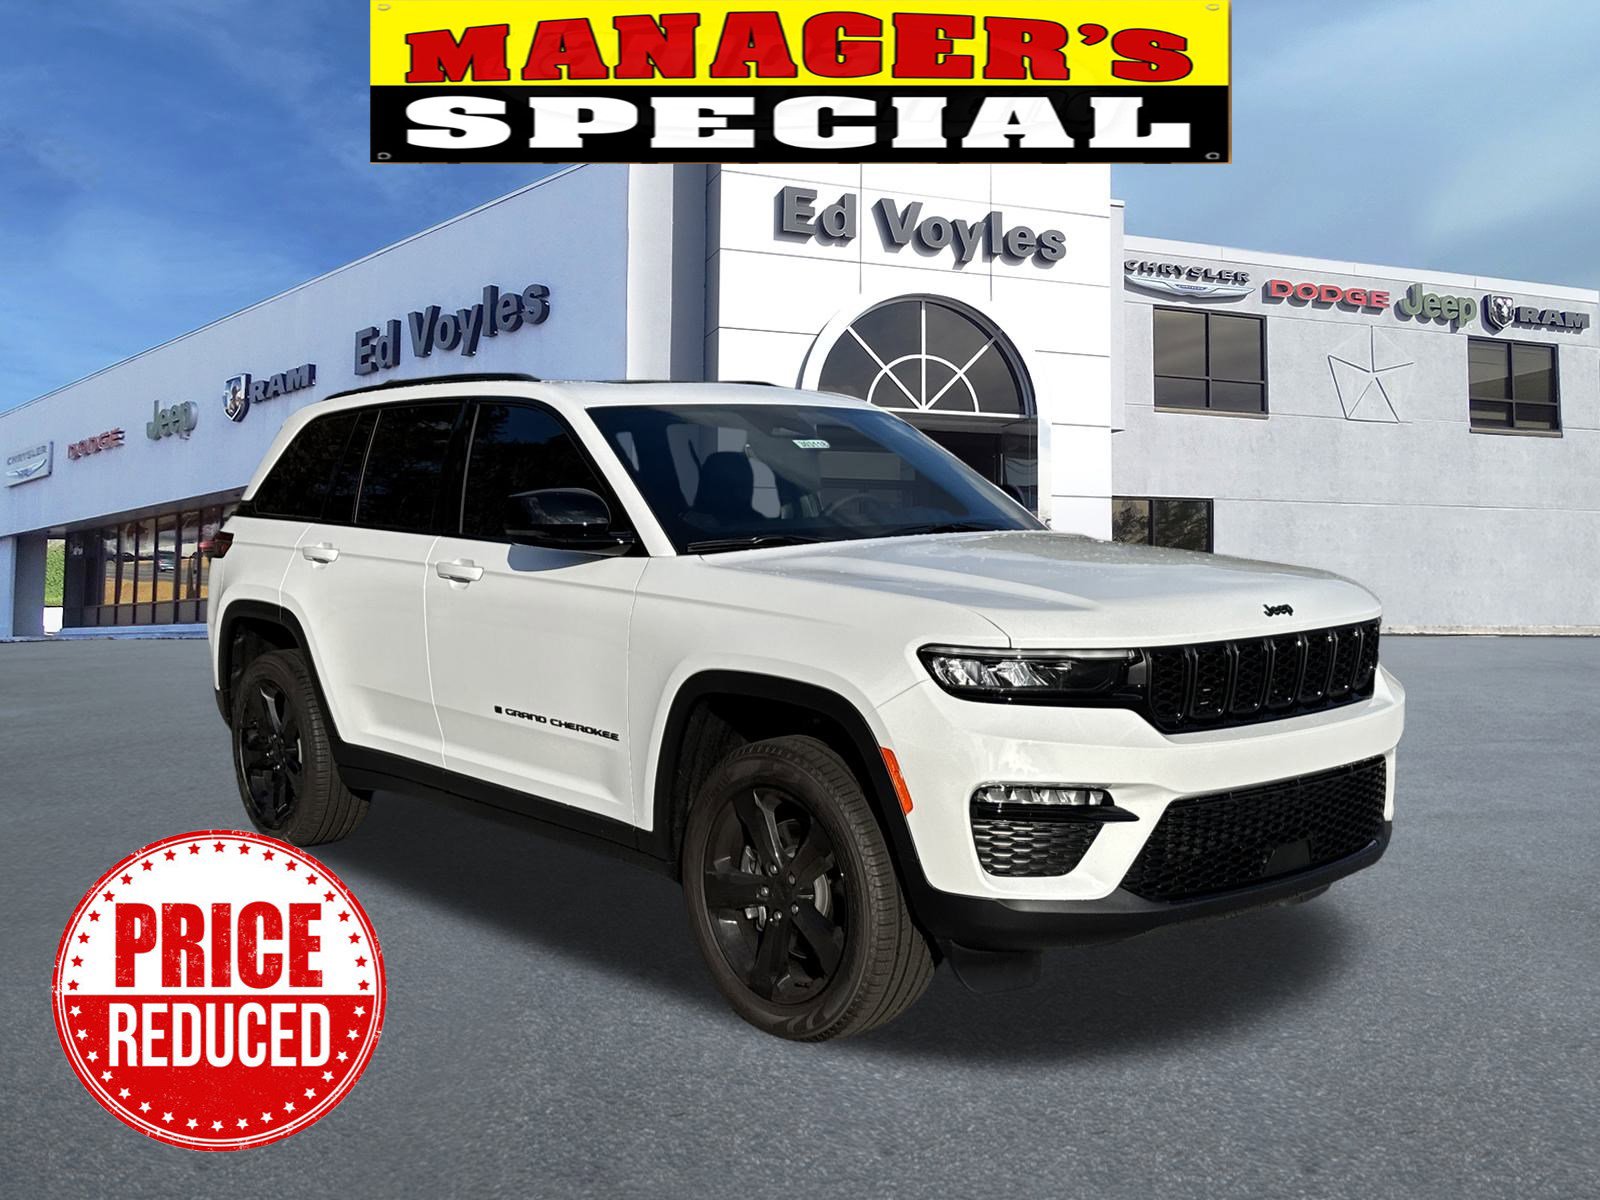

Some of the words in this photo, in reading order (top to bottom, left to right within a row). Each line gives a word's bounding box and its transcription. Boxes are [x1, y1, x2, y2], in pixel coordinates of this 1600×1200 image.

[774, 186, 857, 247] Ed
[871, 198, 1067, 269] Voyles
[1124, 259, 1251, 285] CHRYSLER
[1266, 278, 1391, 313] DODGE
[1398, 283, 1477, 331] Jeep
[355, 320, 401, 376] Ed
[408, 284, 550, 357] Voyles
[1516, 306, 1590, 333] RAM
[249, 364, 316, 403] RAM
[146, 400, 199, 440] Jeep
[67, 428, 125, 460] DODGE
[1263, 604, 1293, 617] Jeep
[505, 708, 547, 724] GRAND
[550, 718, 620, 741] CHEROKEE
